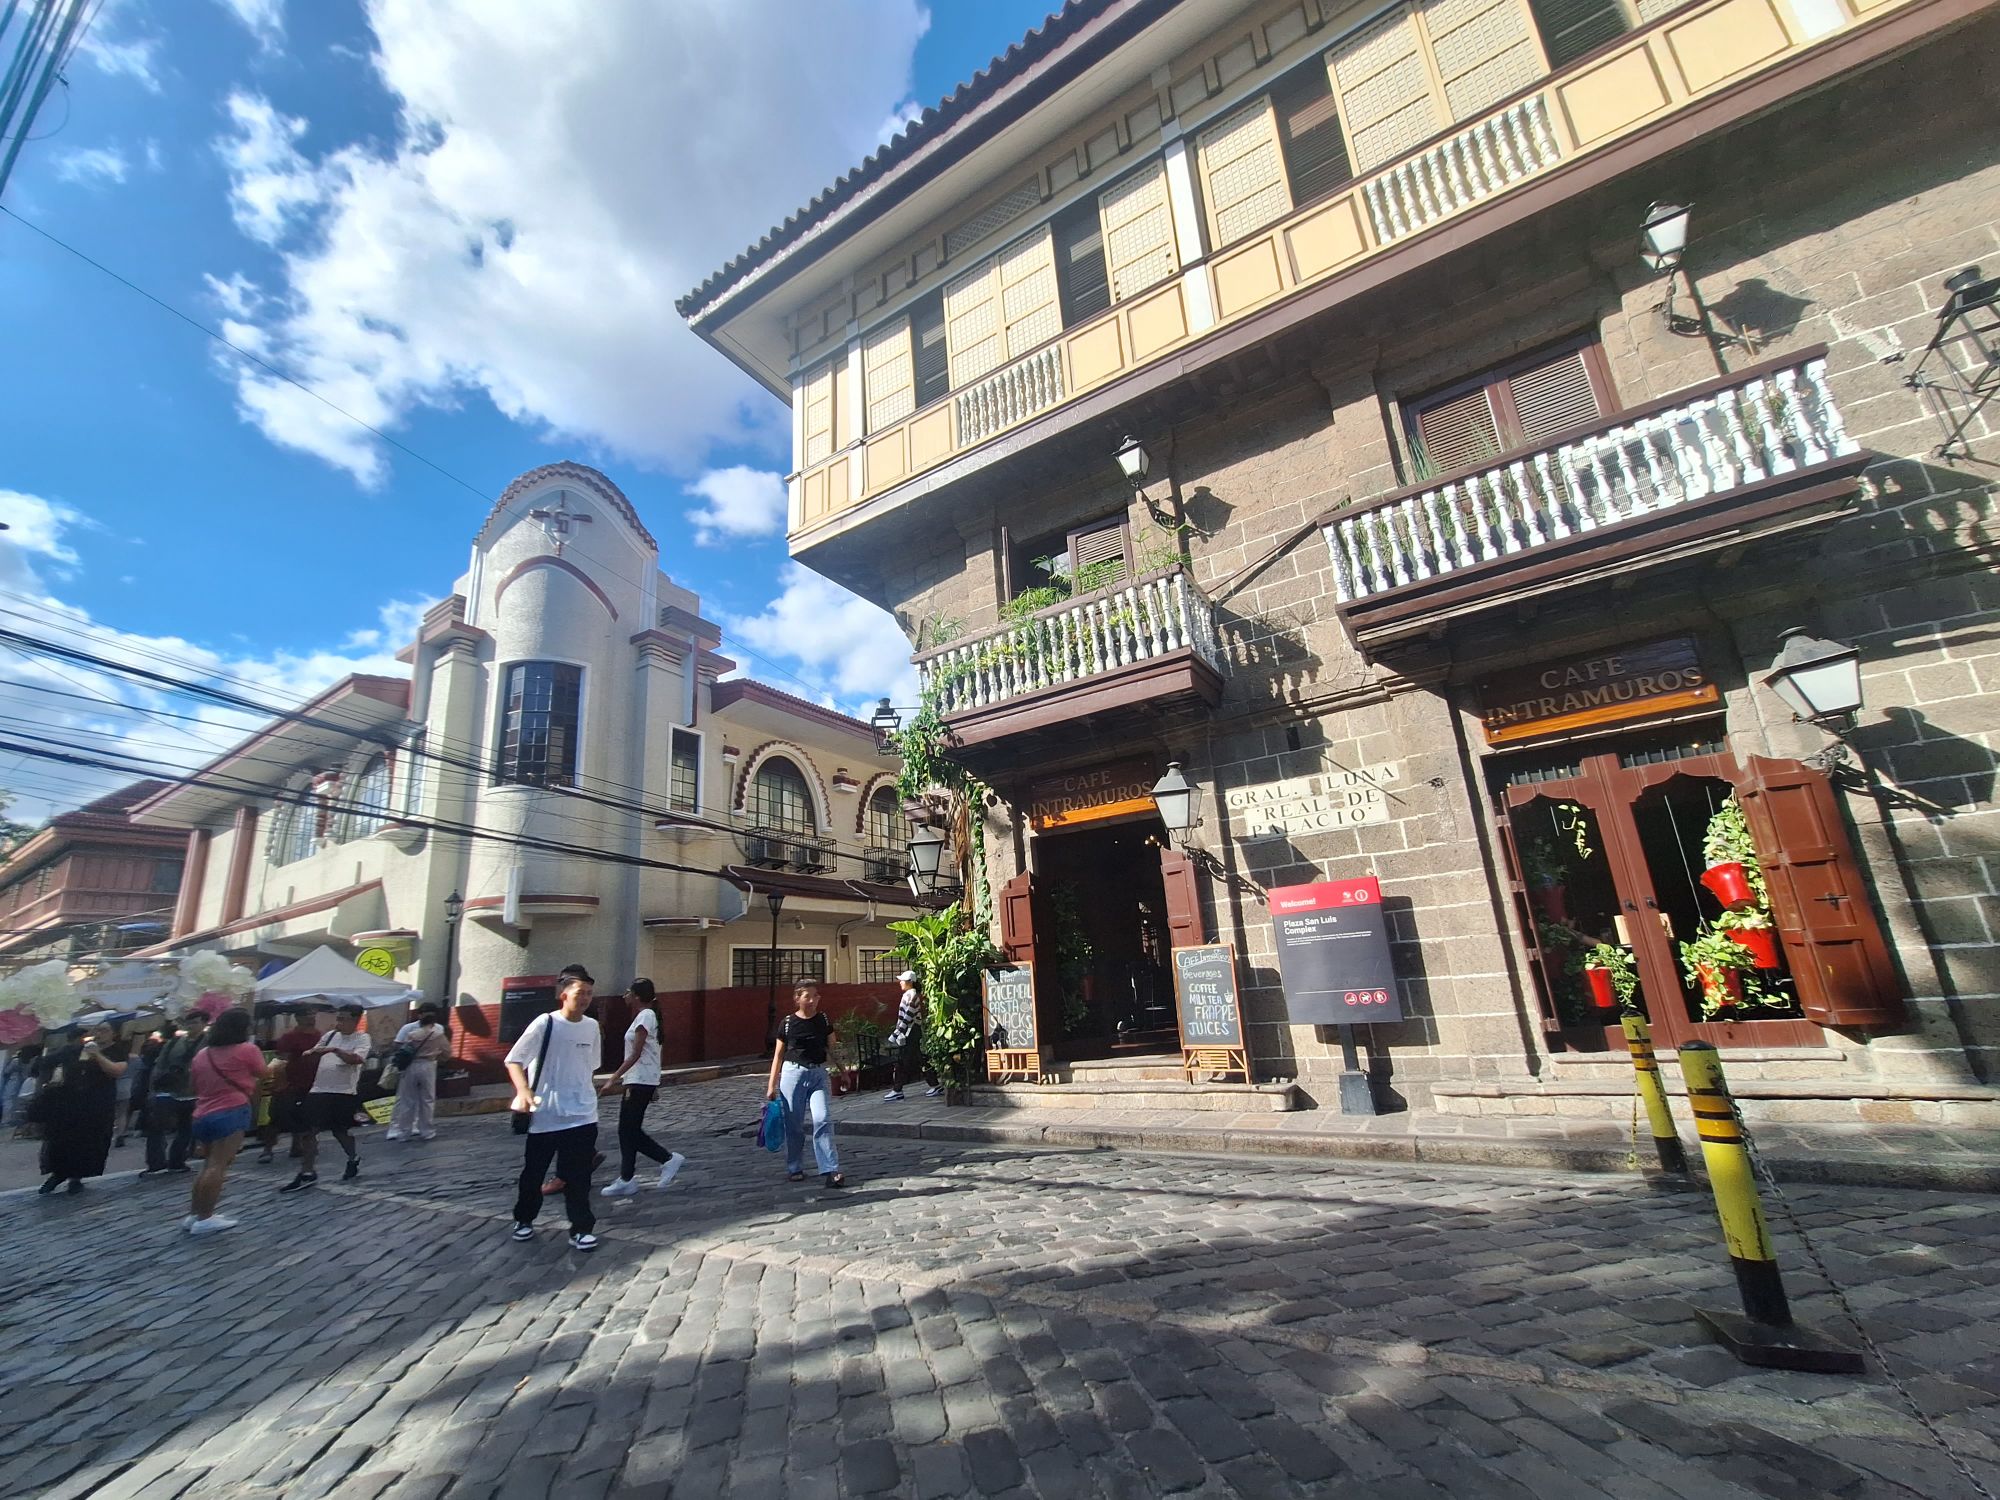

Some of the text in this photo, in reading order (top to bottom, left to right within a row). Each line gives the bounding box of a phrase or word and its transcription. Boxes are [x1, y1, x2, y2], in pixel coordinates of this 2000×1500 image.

[1540, 655, 1626, 689] CAFE
[1486, 666, 1703, 727] INTRAMUROS
[1064, 770, 1112, 792] CAFE
[1230, 766, 1395, 807] GRAL. LUNA
[1032, 781, 1152, 818] INTRAMUROS
[1348, 788, 1380, 806] DE
[1280, 898, 1316, 908] Welcome!
[1283, 915, 1337, 928] Plaza San Luis
[1284, 926, 1317, 935] Complex
[1188, 983, 1218, 994] COFFEE
[989, 999, 1019, 1013] PASTA
[1189, 993, 1222, 1005] MILK TEA
[989, 1012, 1032, 1030] SNACKS
[1194, 1004, 1237, 1021] FRAPPE
[1188, 1021, 1229, 1036] JUICES
